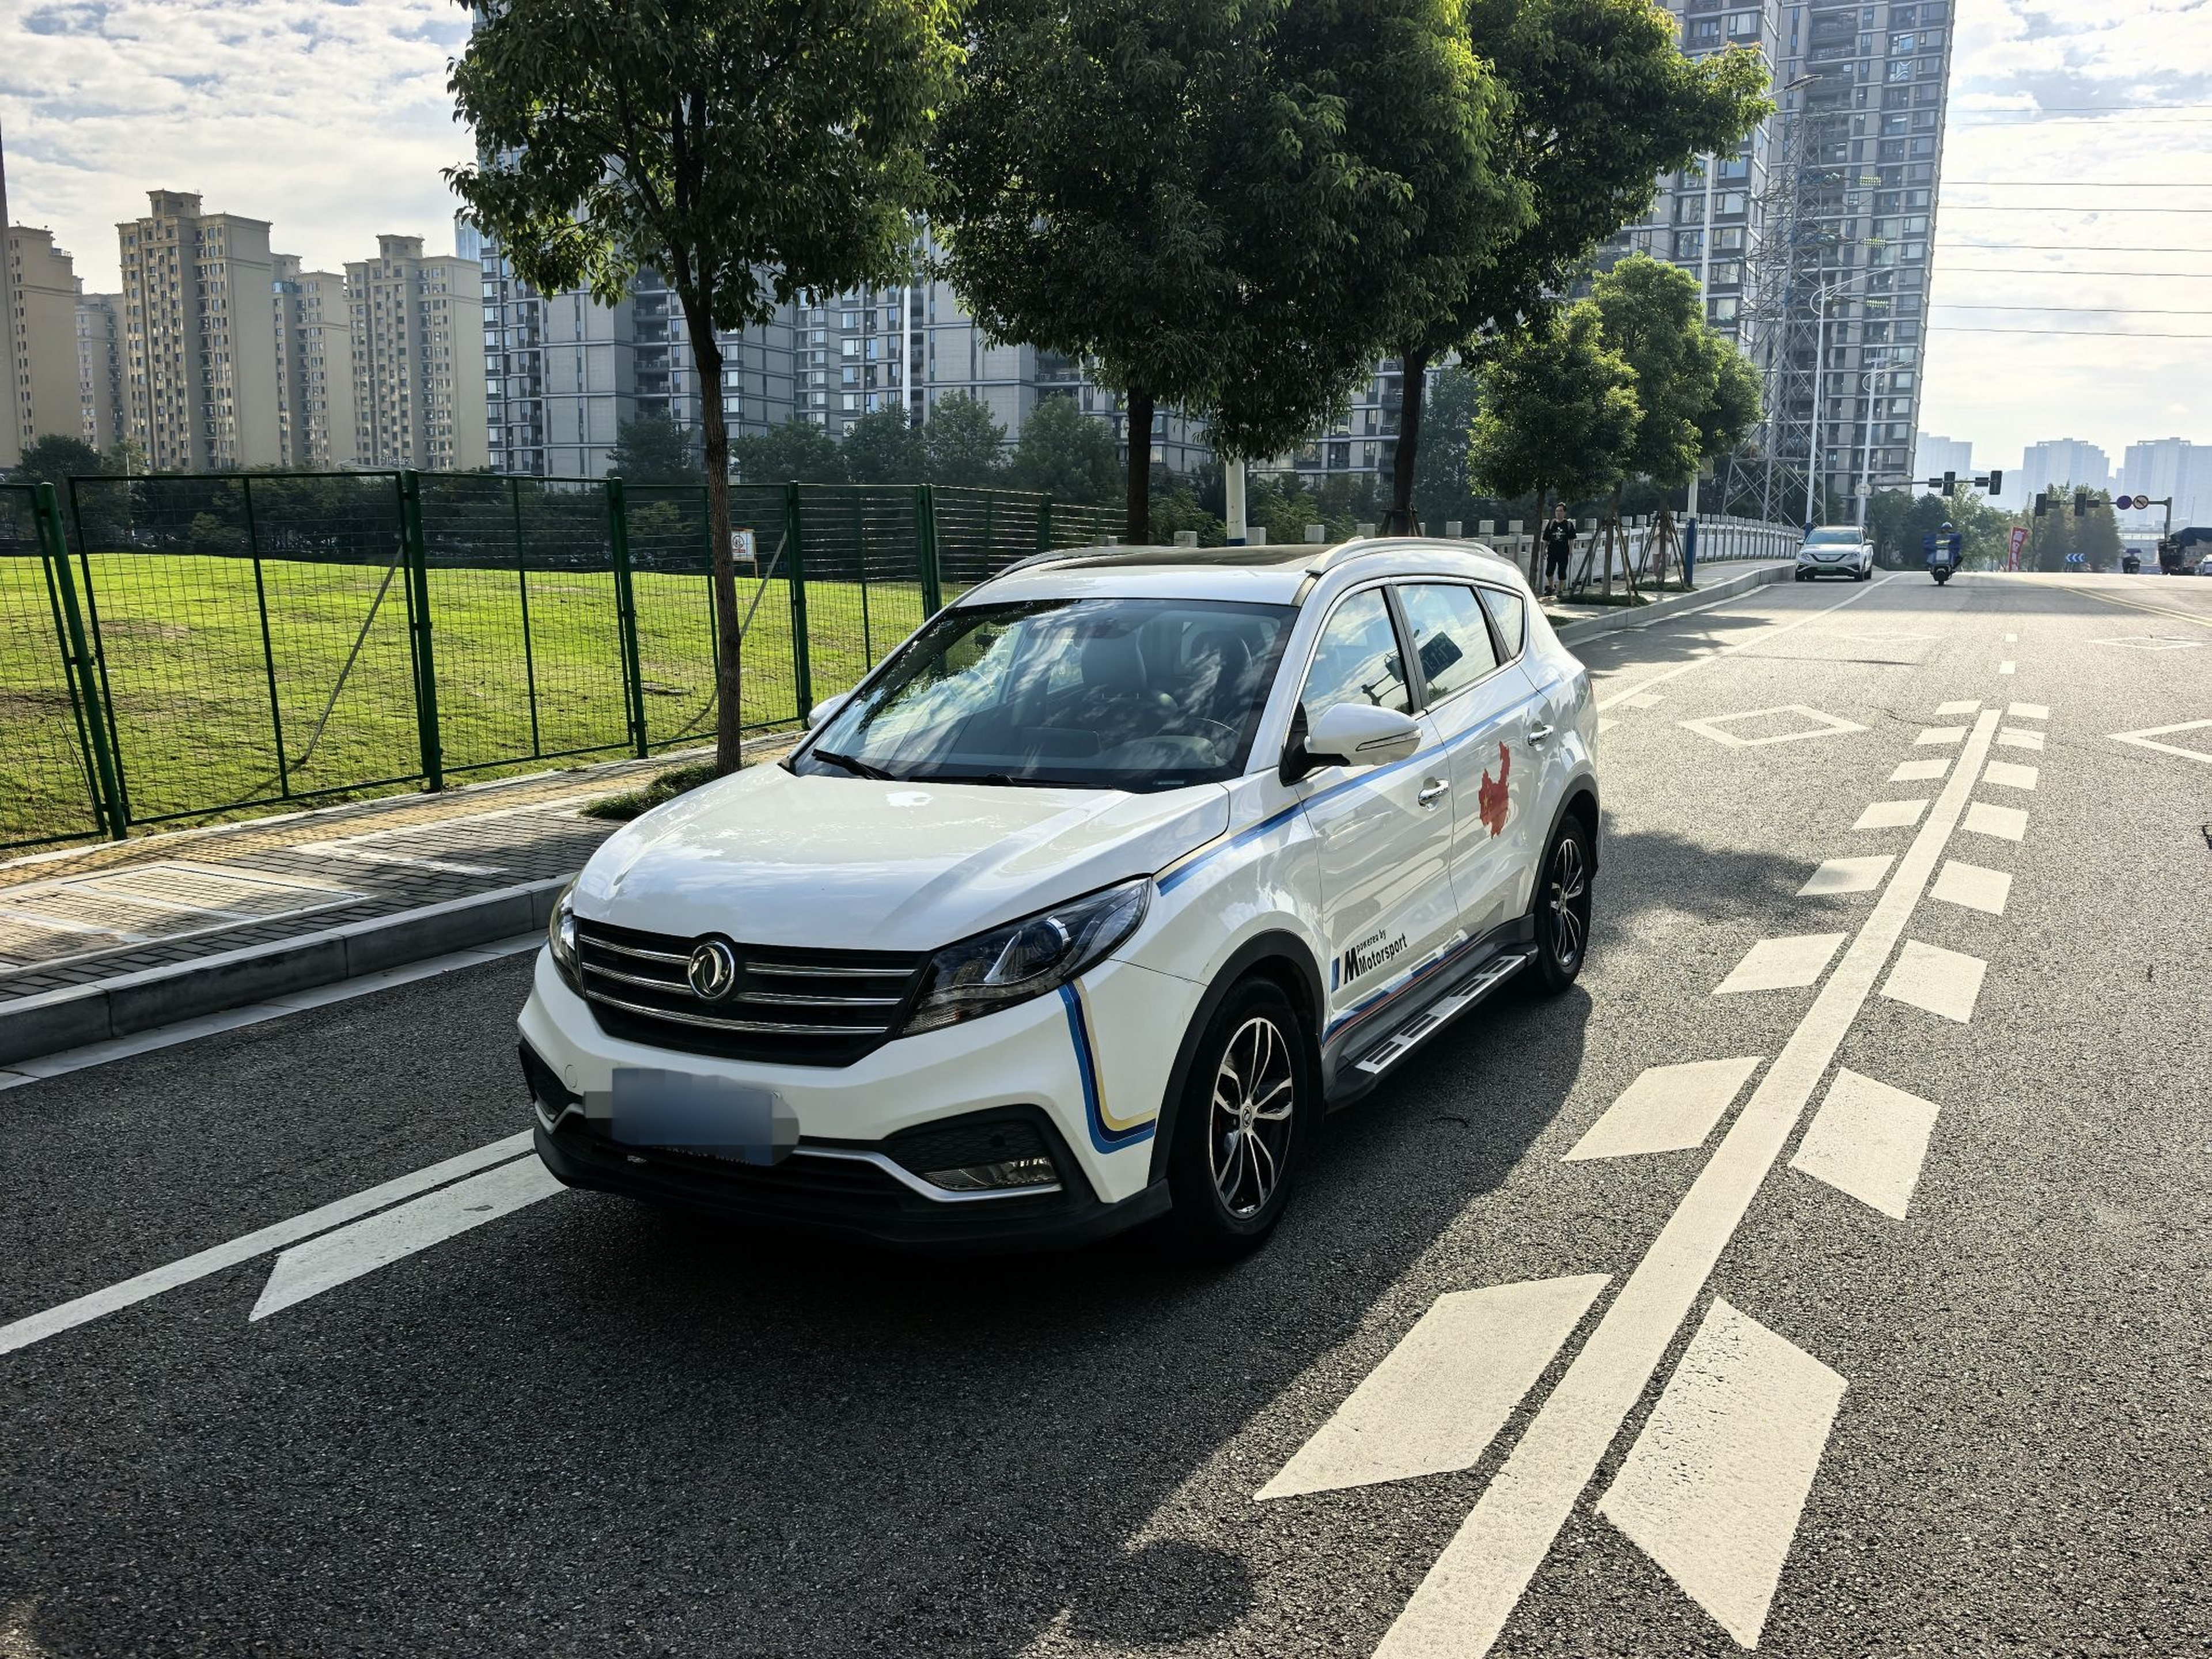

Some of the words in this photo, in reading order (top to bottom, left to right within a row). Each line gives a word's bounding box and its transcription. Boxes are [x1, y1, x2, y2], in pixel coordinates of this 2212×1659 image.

[1378, 929, 1387, 940] by
[1343, 946, 1360, 985] M
[1358, 933, 1407, 975] Motorsport
